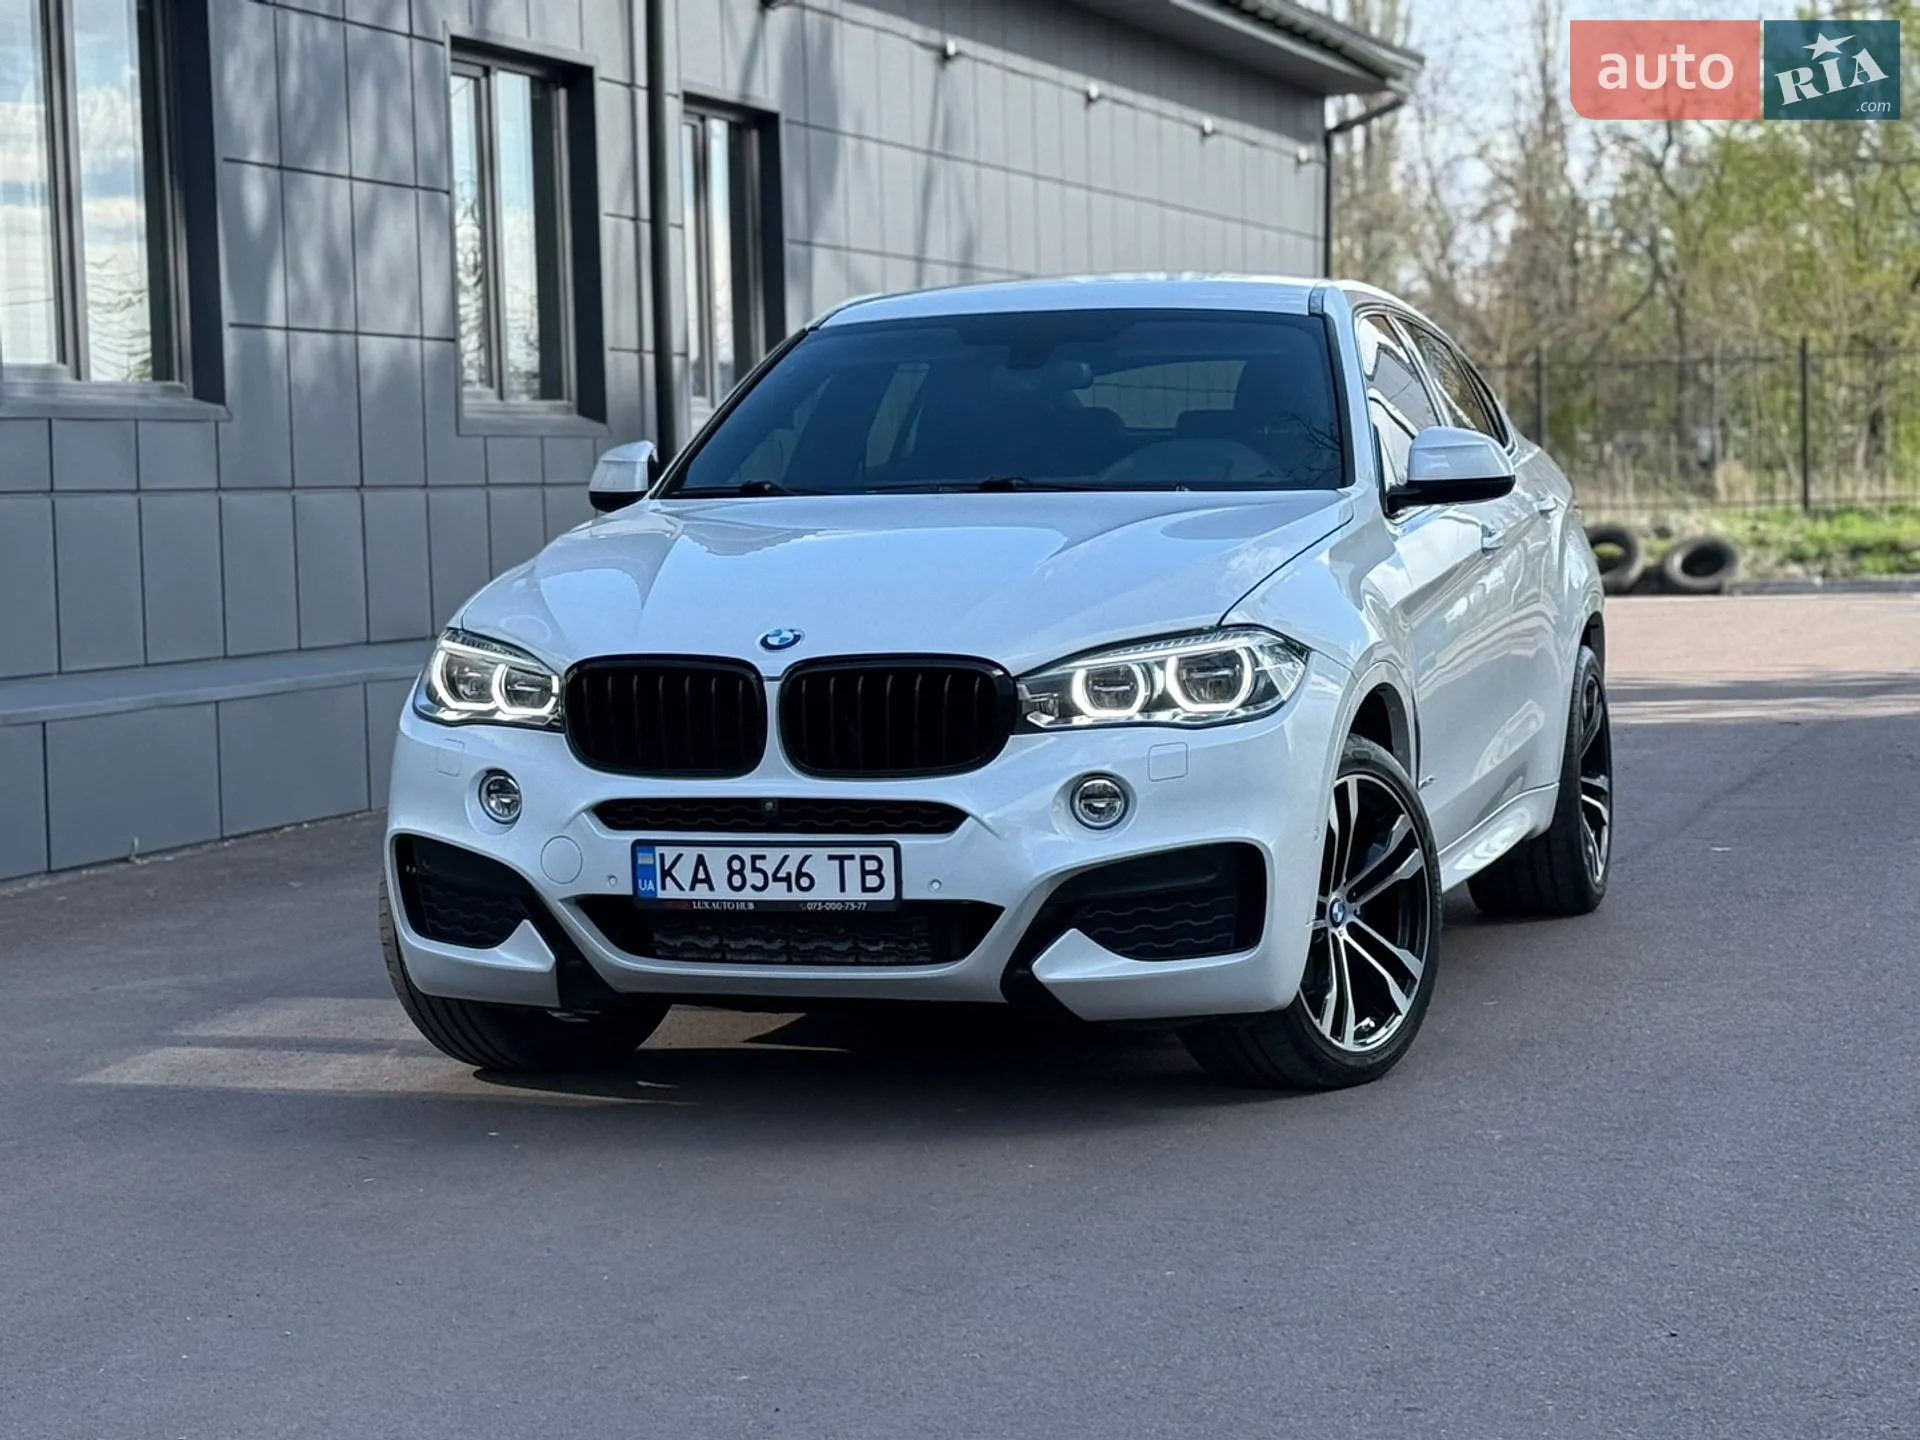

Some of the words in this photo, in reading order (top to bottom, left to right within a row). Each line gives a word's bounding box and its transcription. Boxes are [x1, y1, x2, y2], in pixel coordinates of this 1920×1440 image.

[638, 879, 655, 892] UA
[659, 853, 715, 892] KA
[726, 854, 815, 893] 8546
[827, 854, 885, 893] TB
